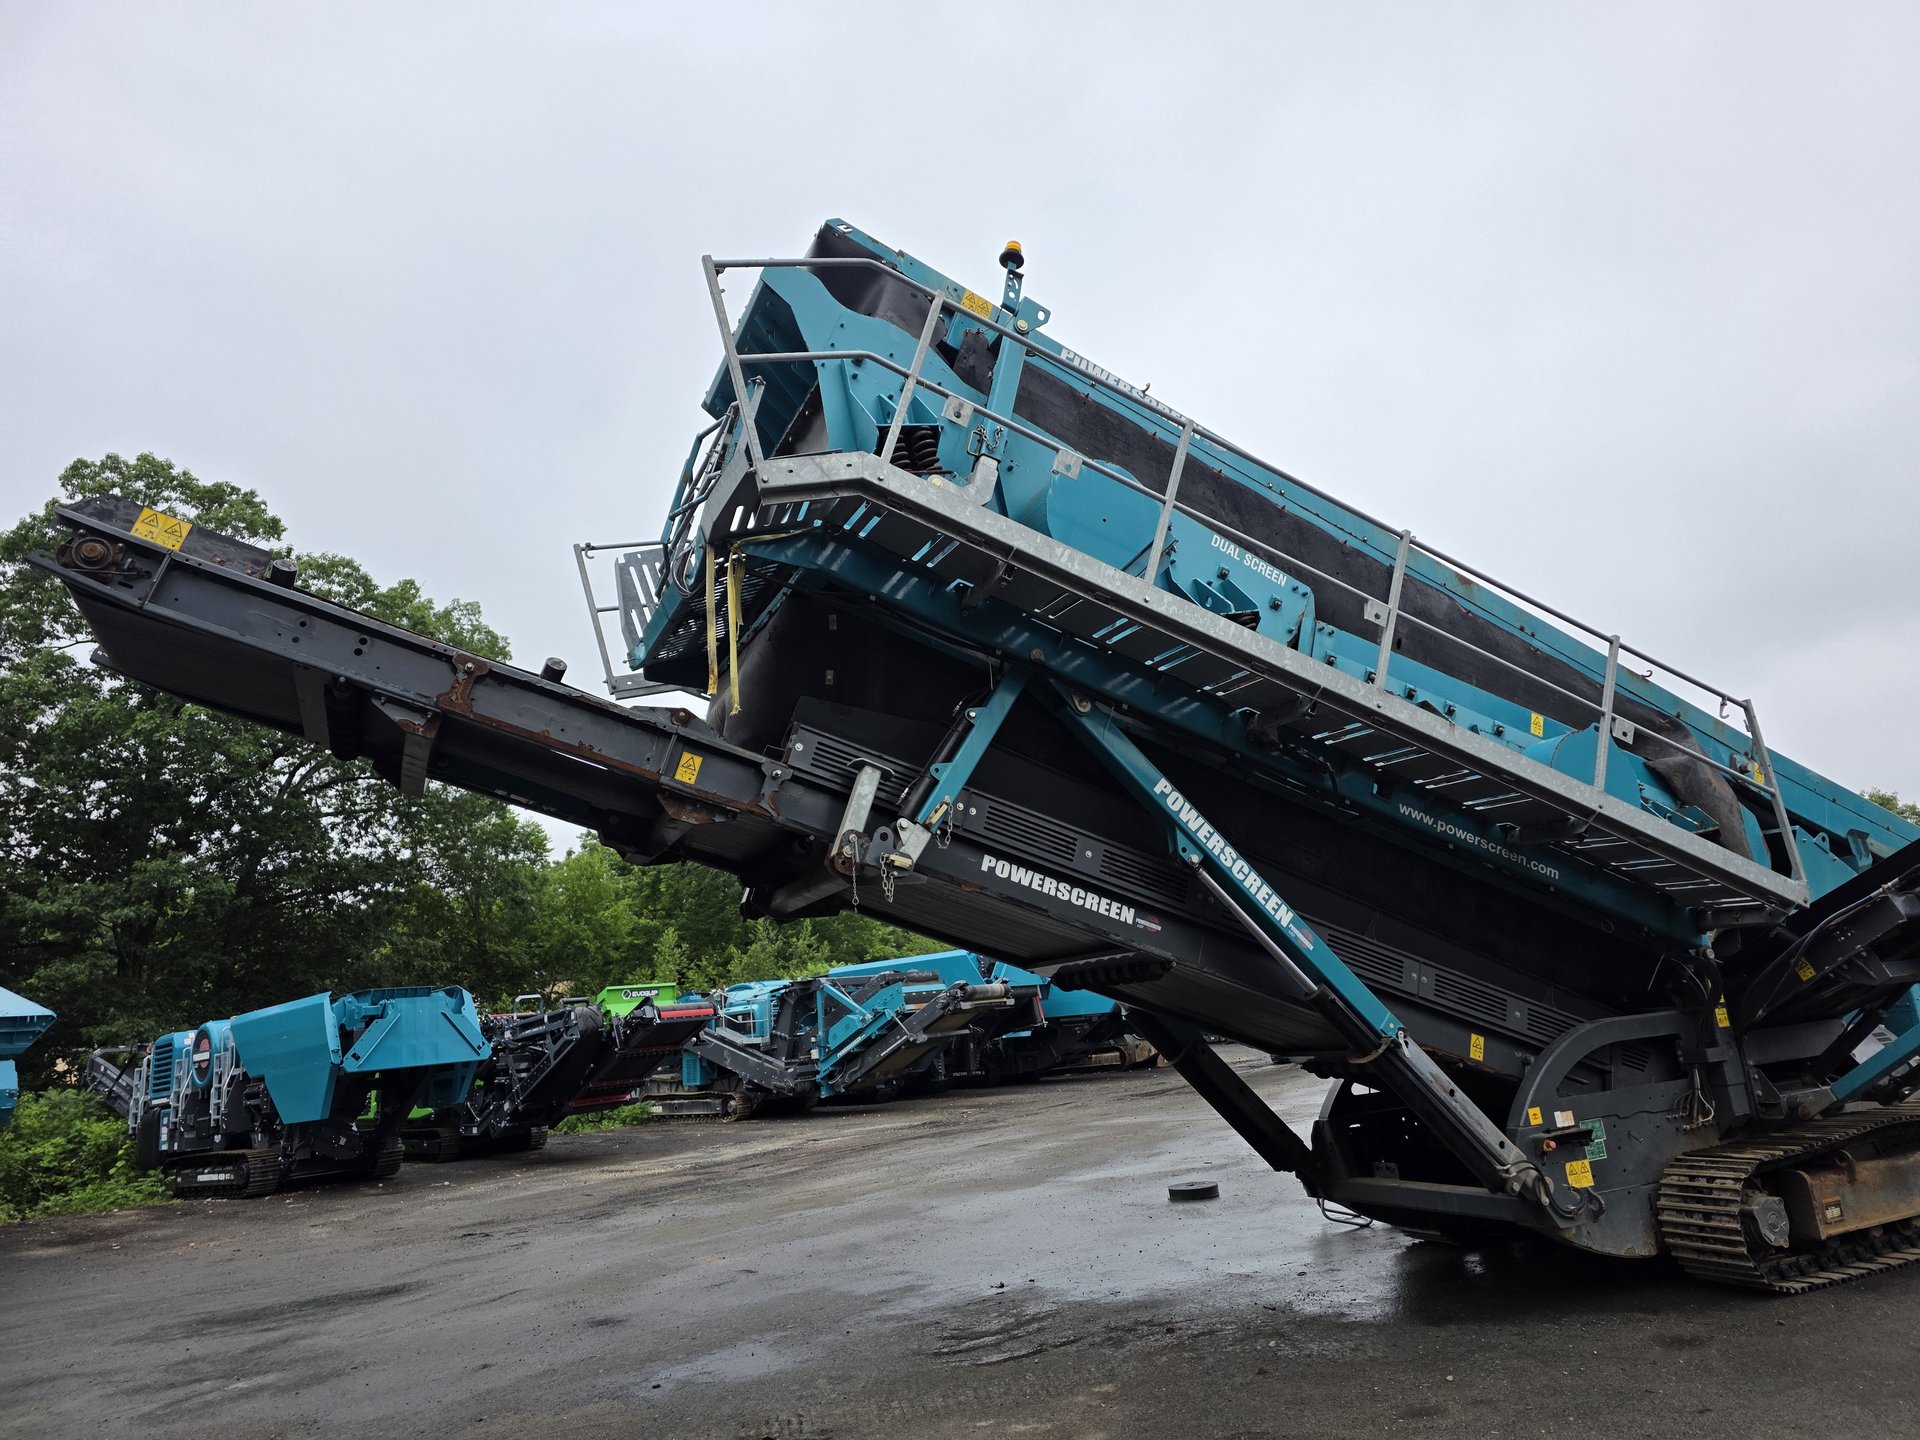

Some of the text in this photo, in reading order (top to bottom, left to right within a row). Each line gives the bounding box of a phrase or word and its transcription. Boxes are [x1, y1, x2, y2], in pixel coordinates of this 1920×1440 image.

[1211, 534, 1287, 587] DUAL SCREEN
[1153, 777, 1294, 928] POWERSCREEN
[1399, 803, 1560, 880] www.powerscreen.com
[980, 854, 1136, 925] POWERSCREEN
